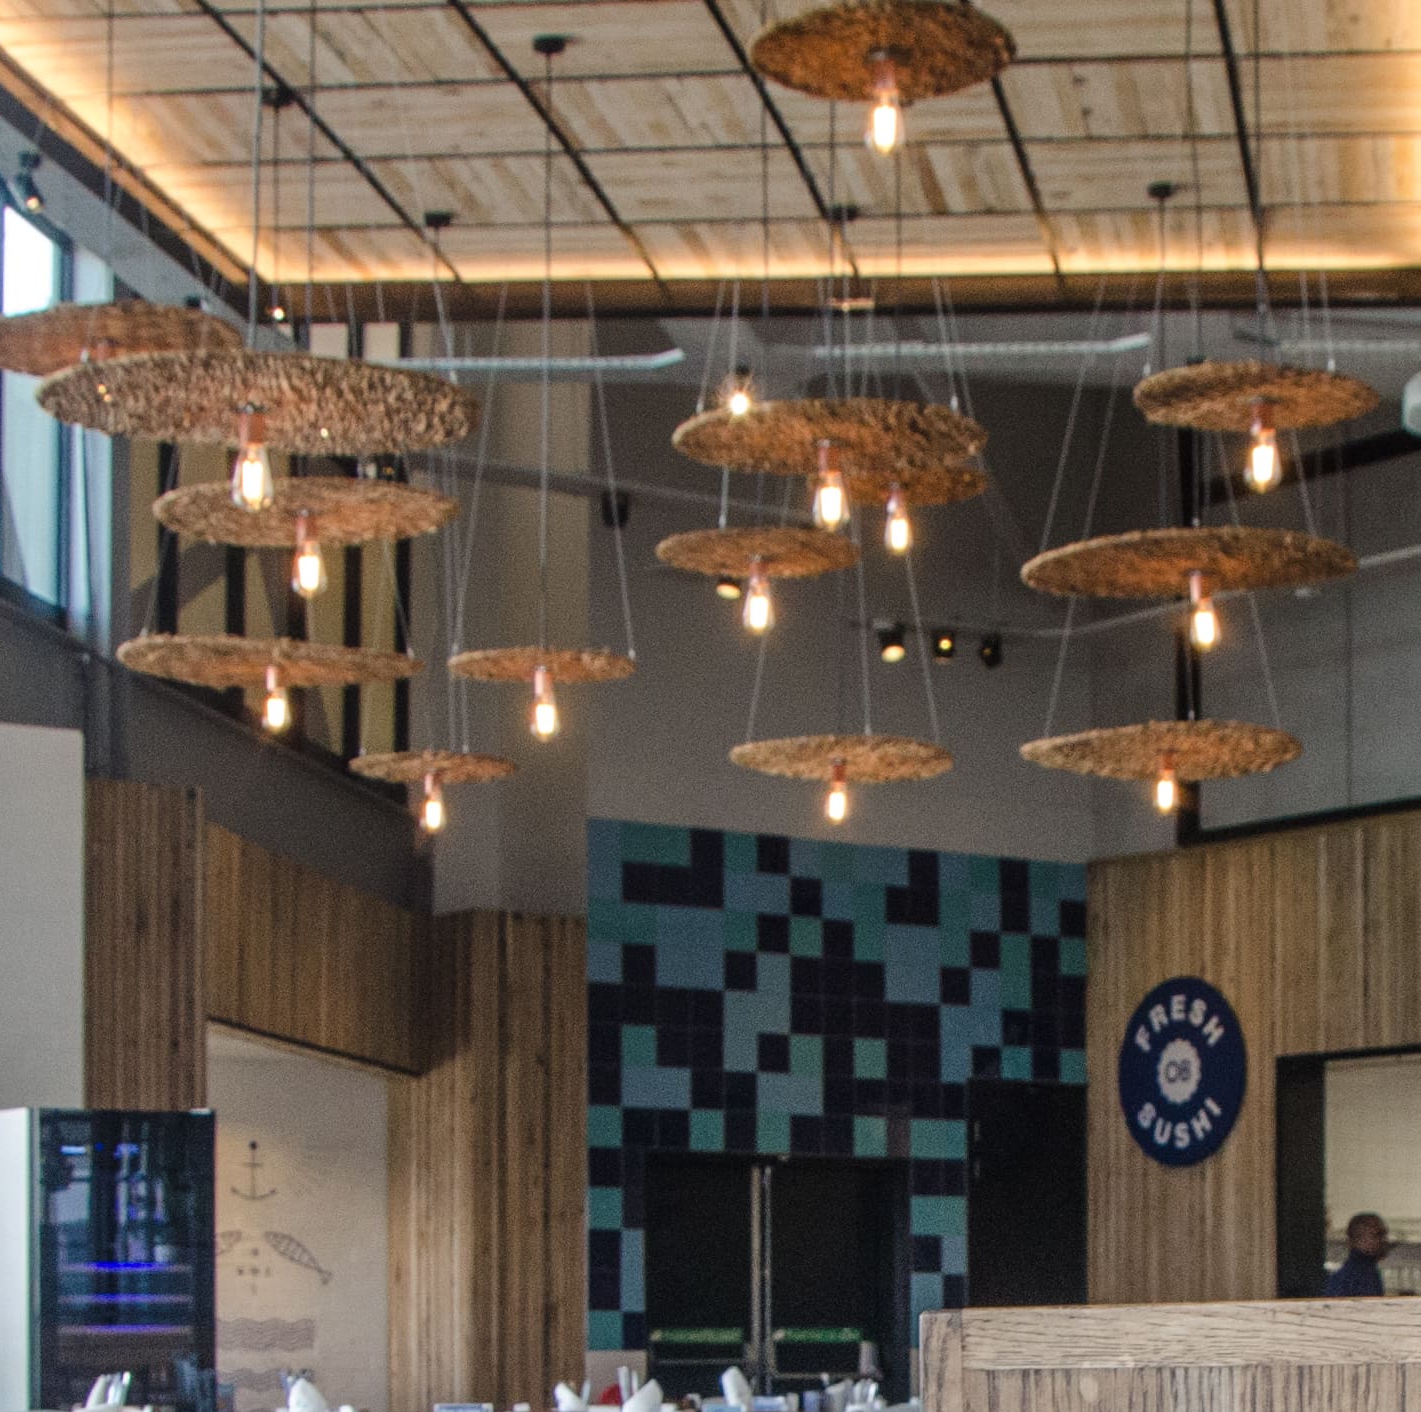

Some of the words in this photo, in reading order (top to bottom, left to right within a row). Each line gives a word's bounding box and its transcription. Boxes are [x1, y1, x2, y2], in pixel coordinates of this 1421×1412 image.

[1134, 994, 1225, 1053] FRESH
[1164, 1060, 1192, 1083] OB
[1137, 1097, 1222, 1149] SUSHI
